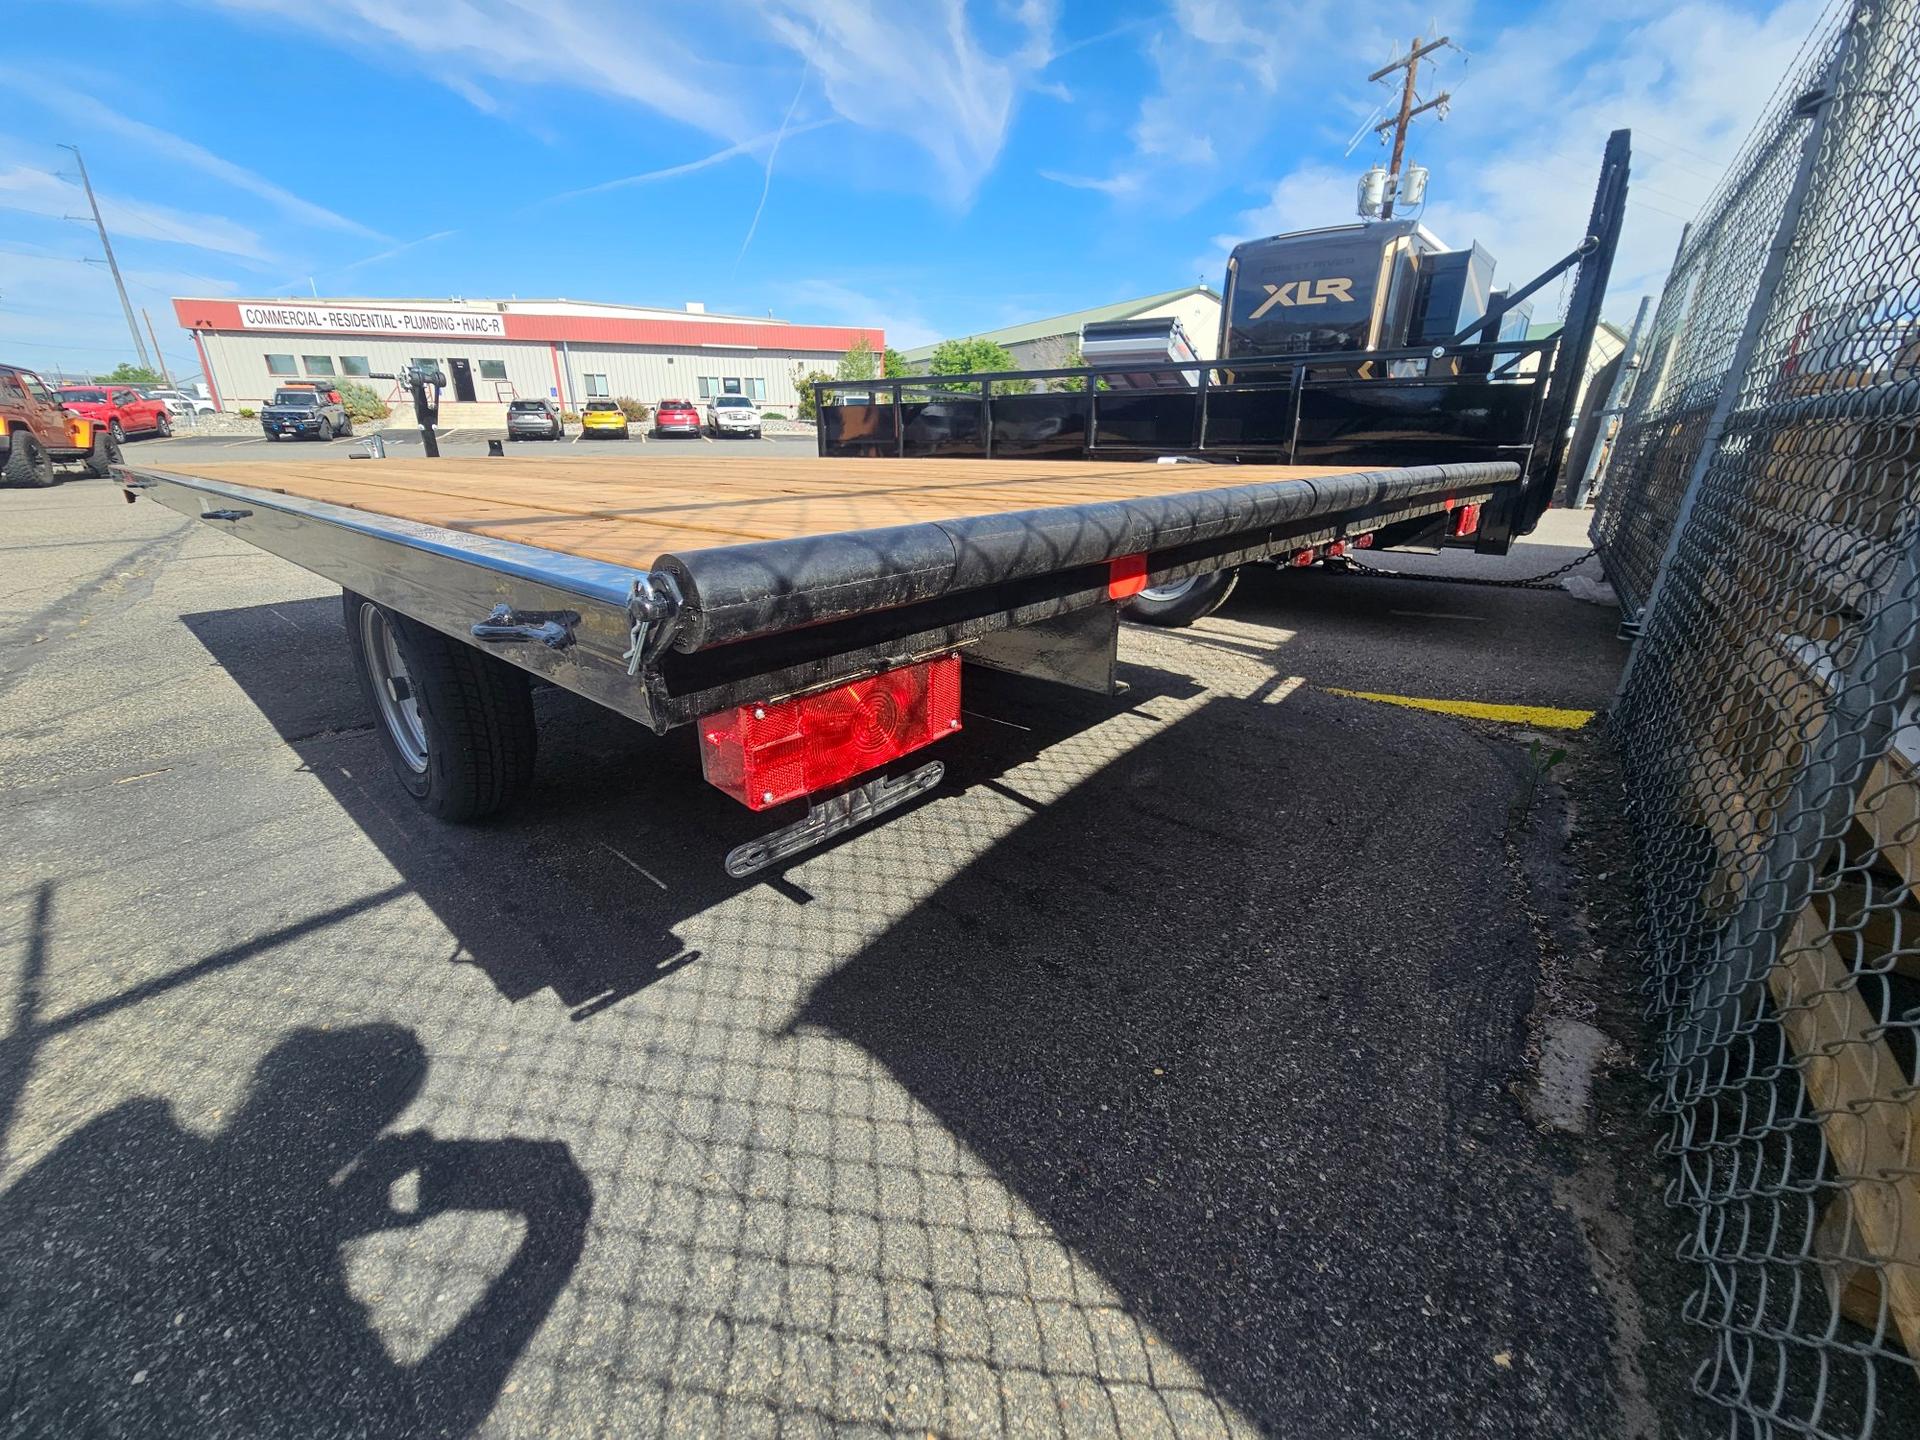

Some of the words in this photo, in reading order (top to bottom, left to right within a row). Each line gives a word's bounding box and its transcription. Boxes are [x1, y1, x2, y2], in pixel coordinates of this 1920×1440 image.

[1249, 278, 1354, 319] XLR
[246, 308, 323, 326] COMMERCIAL
[329, 312, 398, 329] RESIDENTIAL
[404, 315, 455, 331] PLUMBING
[462, 317, 501, 333] HVAC-R
